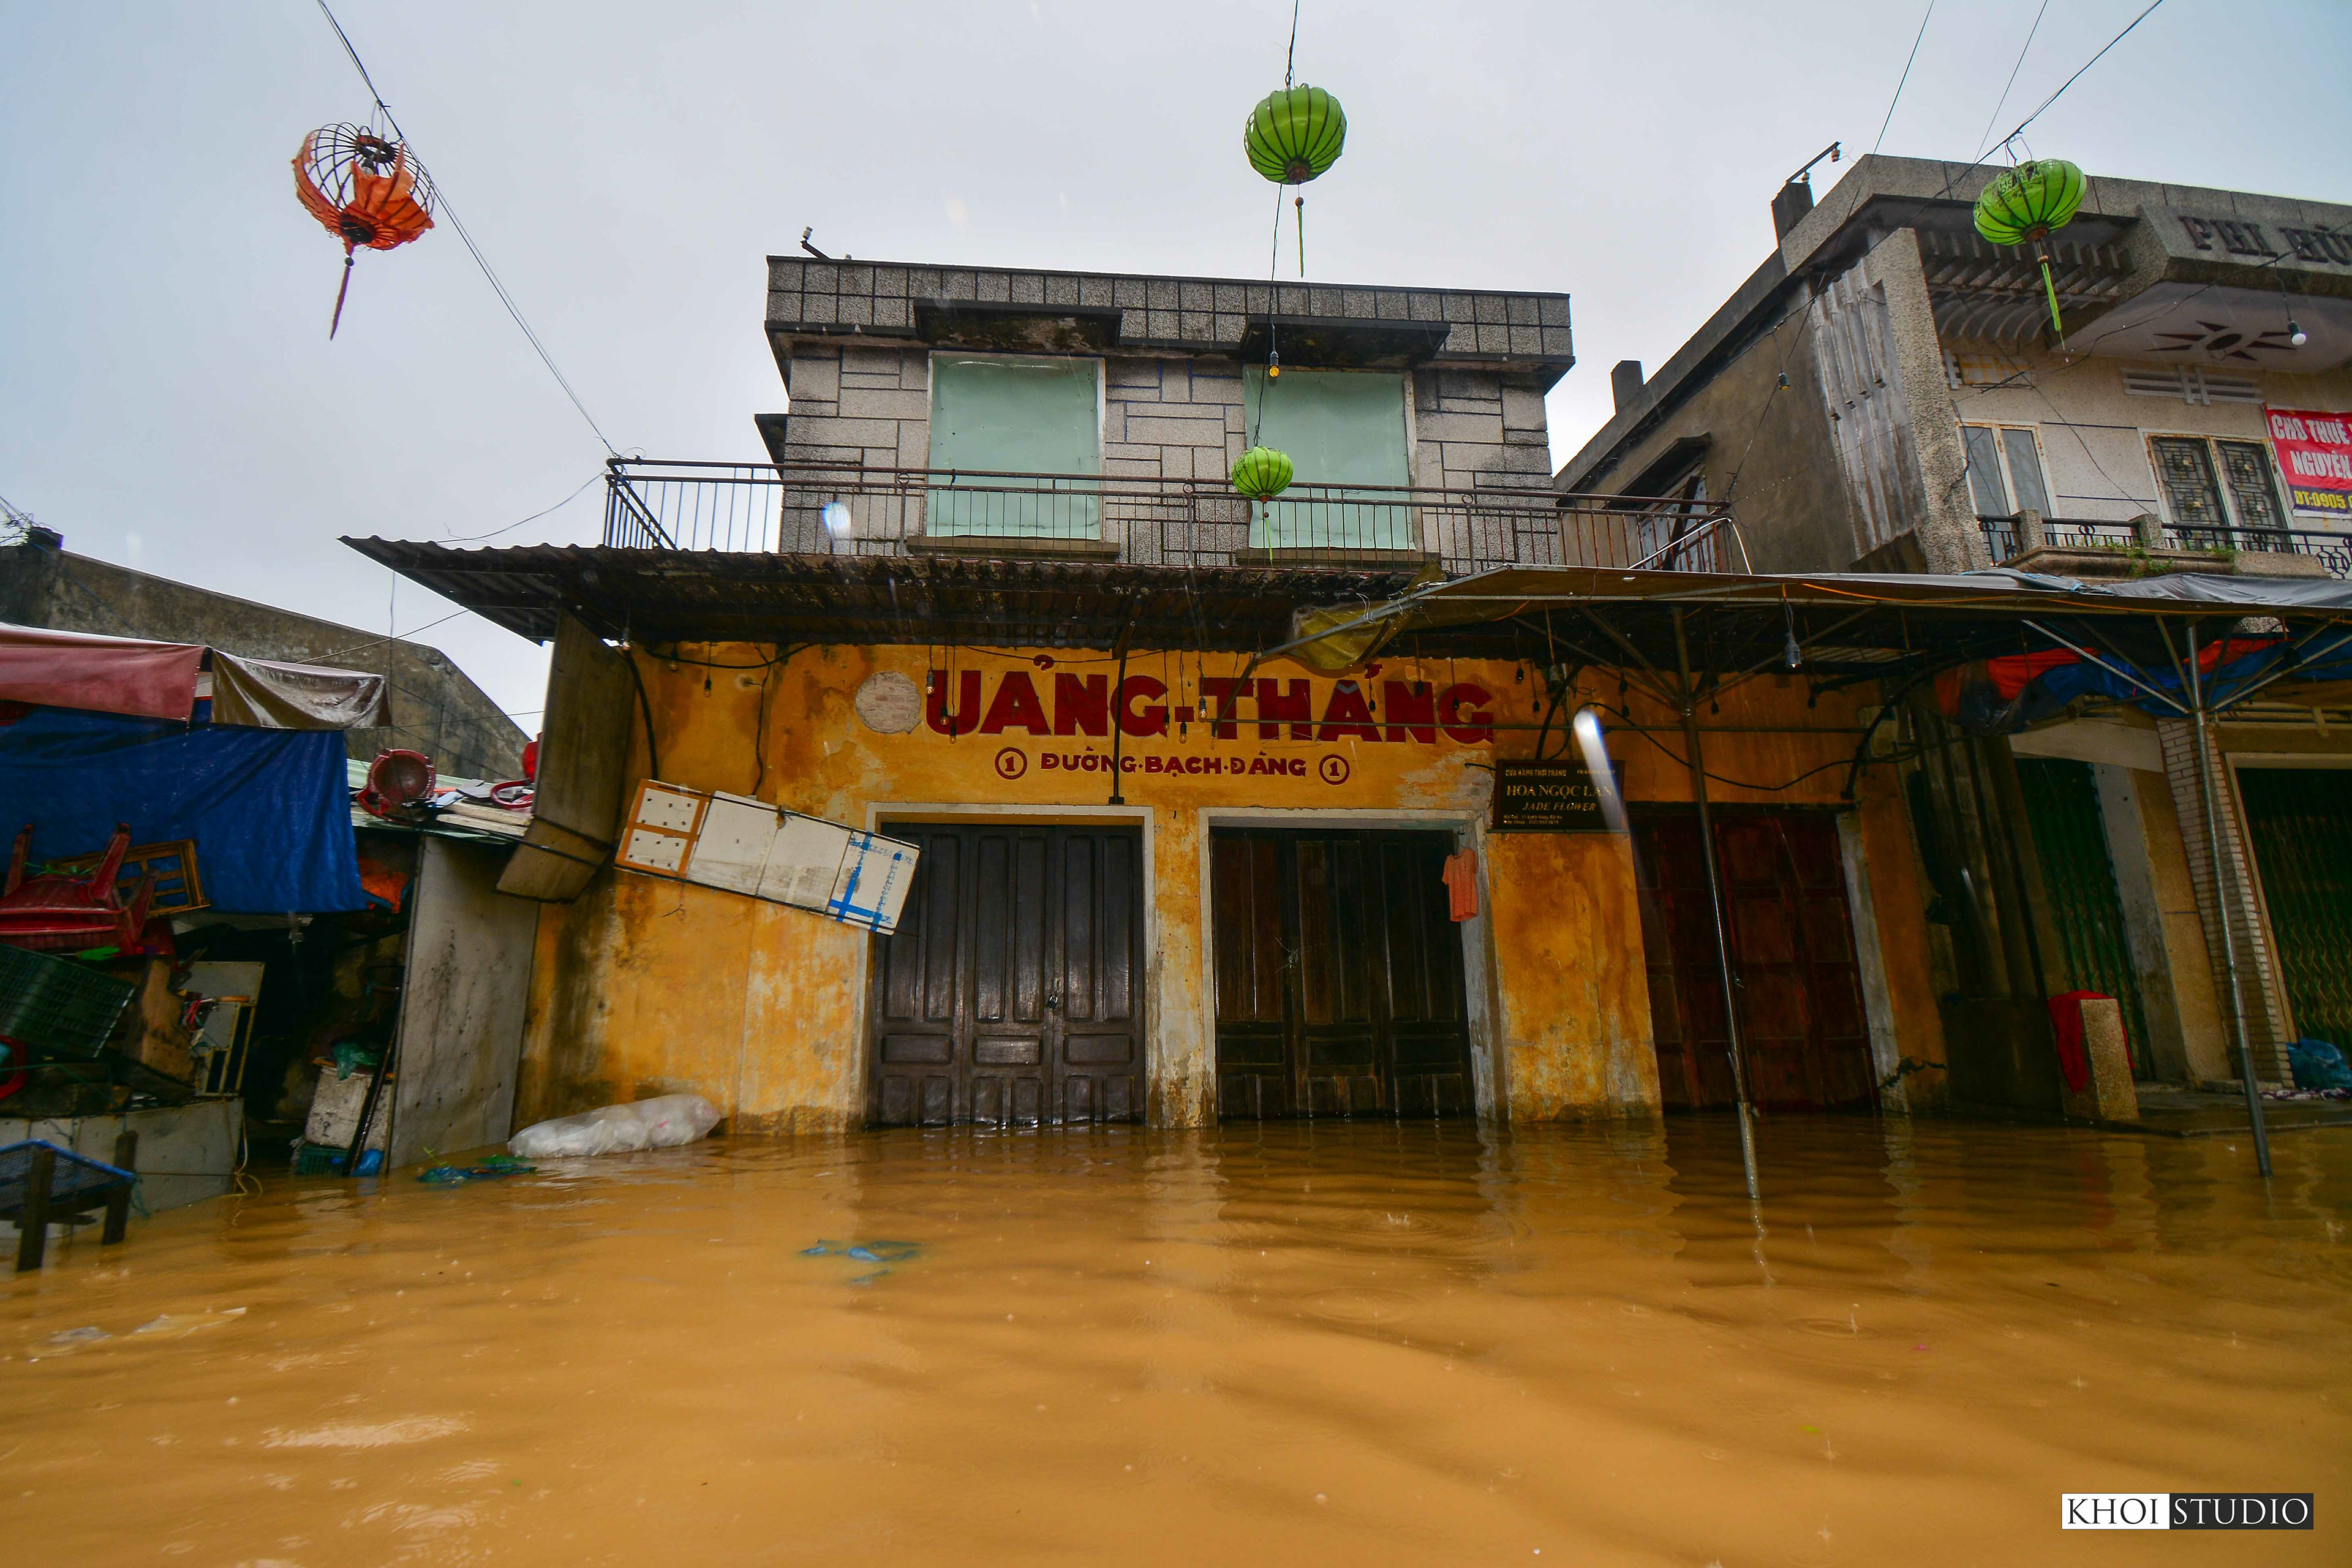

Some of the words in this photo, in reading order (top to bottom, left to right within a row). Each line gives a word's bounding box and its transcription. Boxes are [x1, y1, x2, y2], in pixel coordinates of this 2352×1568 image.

[2271, 414, 2308, 440] CHO
[2305, 418, 2350, 445] THUÊ
[1507, 785, 1536, 796] HOA
[1539, 785, 1580, 799] NGỌC
[1584, 785, 1611, 796] LAN
[1523, 802, 1550, 810] JADE
[1553, 802, 1596, 811] FLOWER
